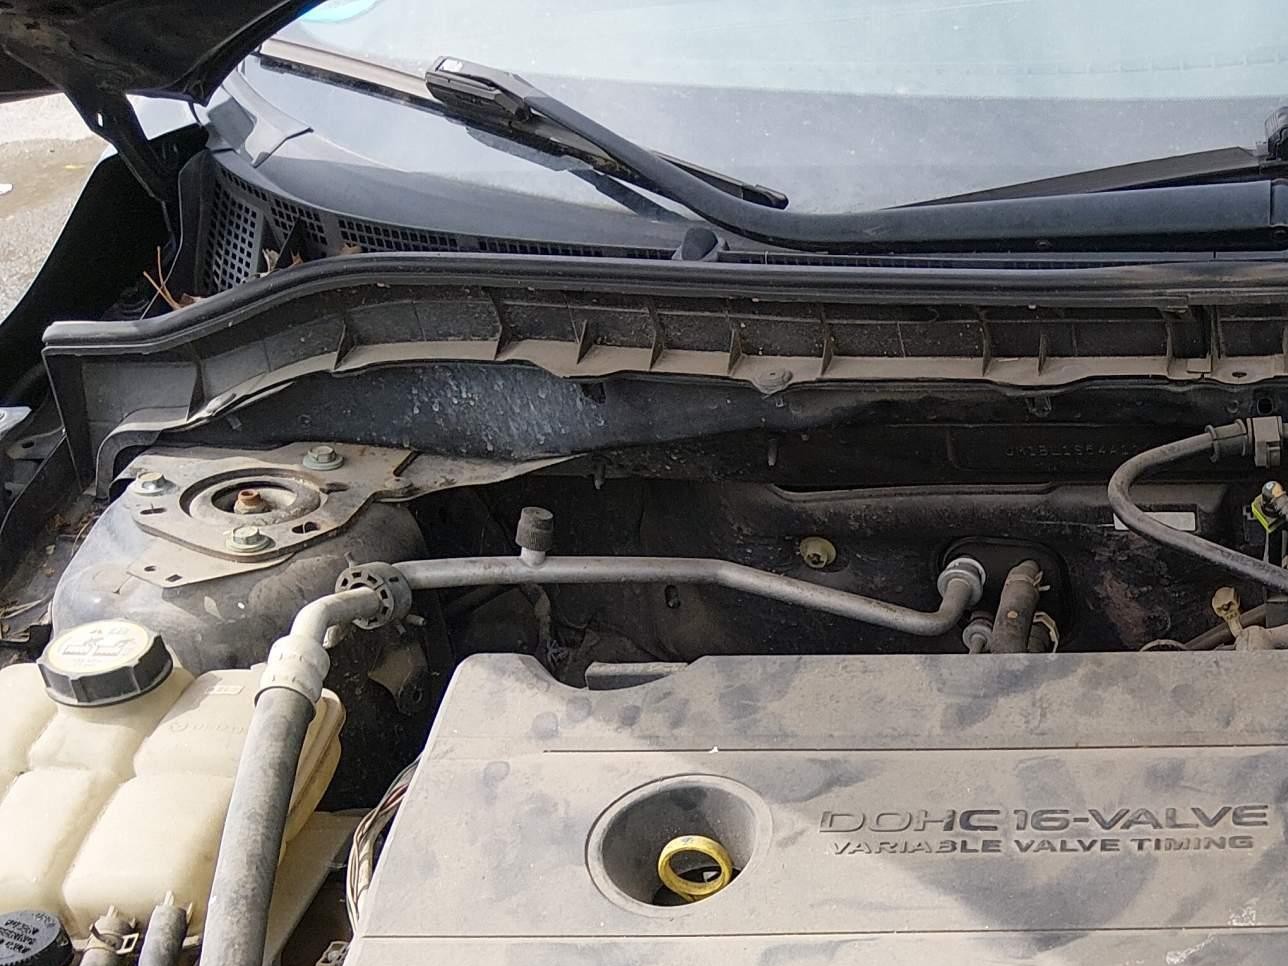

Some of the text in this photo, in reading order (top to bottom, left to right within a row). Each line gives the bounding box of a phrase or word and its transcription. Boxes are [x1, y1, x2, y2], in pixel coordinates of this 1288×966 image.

[817, 803, 1270, 834] DOHC 16-VALVE
[832, 834, 1255, 856] VARIABLE VALVE TIMING
